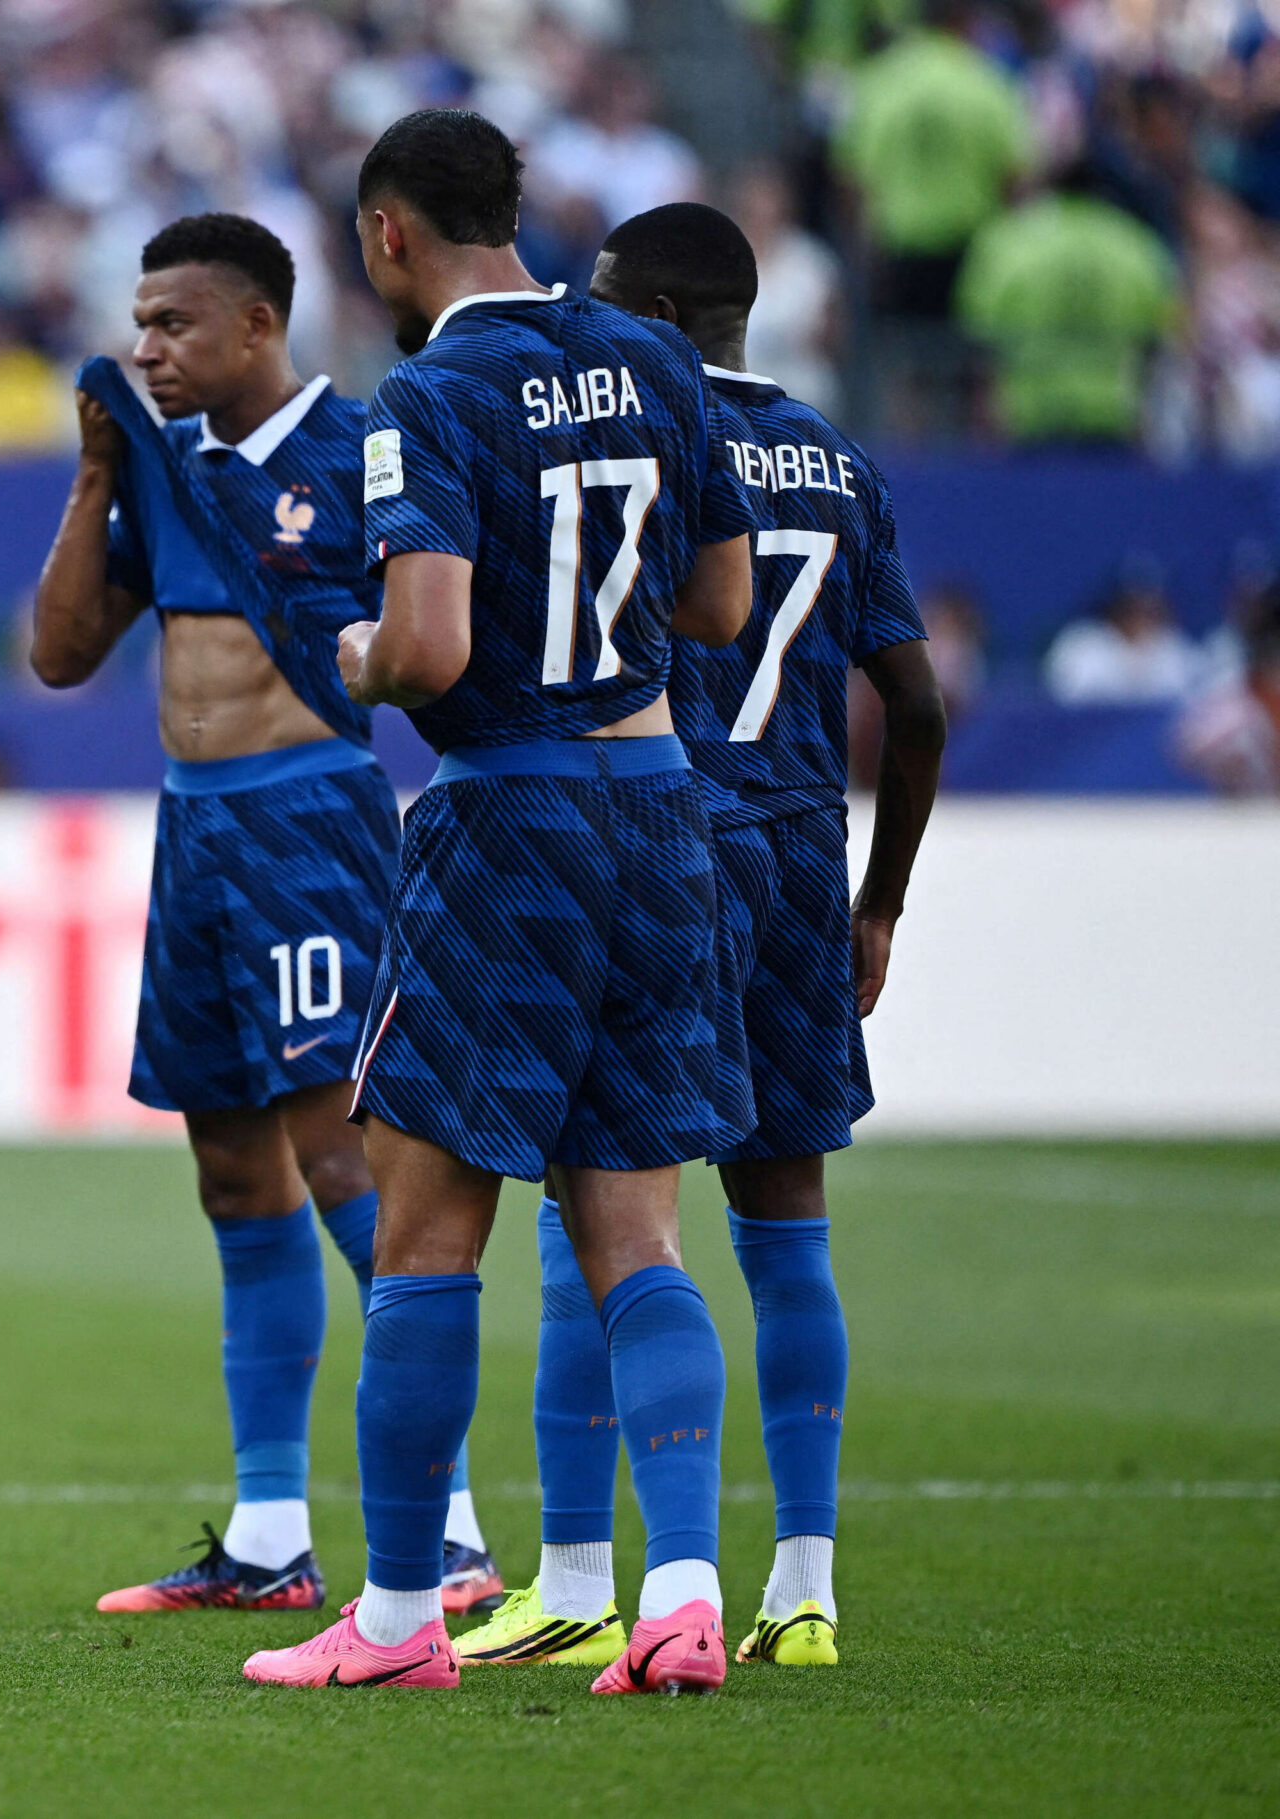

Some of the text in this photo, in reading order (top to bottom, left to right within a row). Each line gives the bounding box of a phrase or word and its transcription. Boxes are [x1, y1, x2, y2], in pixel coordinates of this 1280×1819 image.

[540, 458, 659, 685] 17
[728, 530, 839, 742] 7
[270, 935, 342, 1027] 10
[650, 1428, 709, 1453] FFF
[813, 1403, 844, 1424] FF
